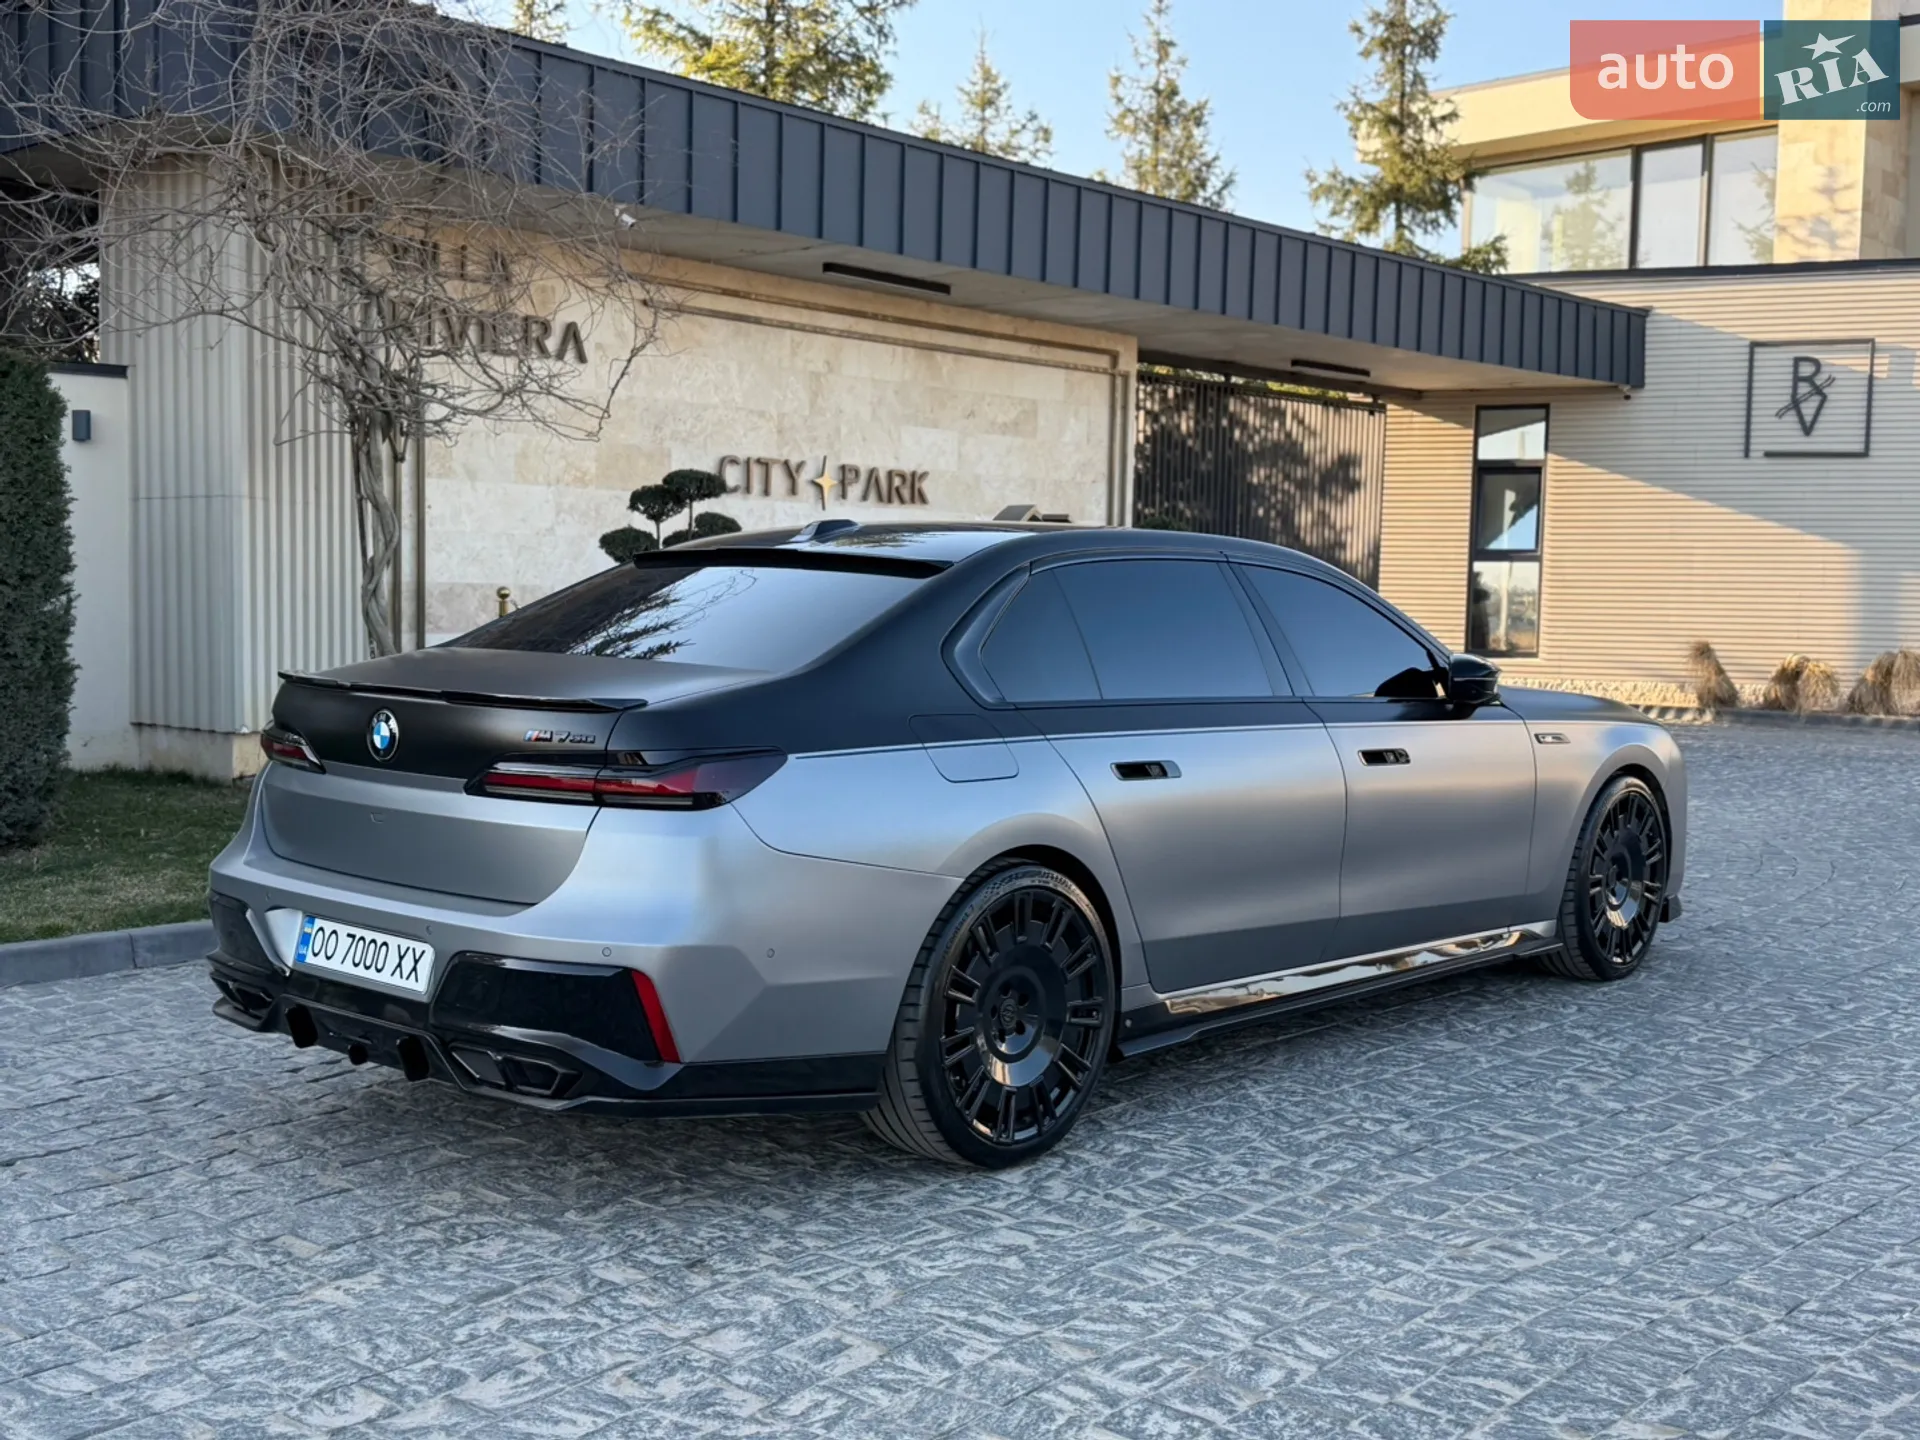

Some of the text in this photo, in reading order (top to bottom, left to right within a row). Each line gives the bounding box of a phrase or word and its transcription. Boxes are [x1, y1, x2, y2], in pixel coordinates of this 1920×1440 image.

[718, 455, 929, 505] CITY PARK
[341, 932, 390, 974] 7000
[390, 944, 426, 983] XX
